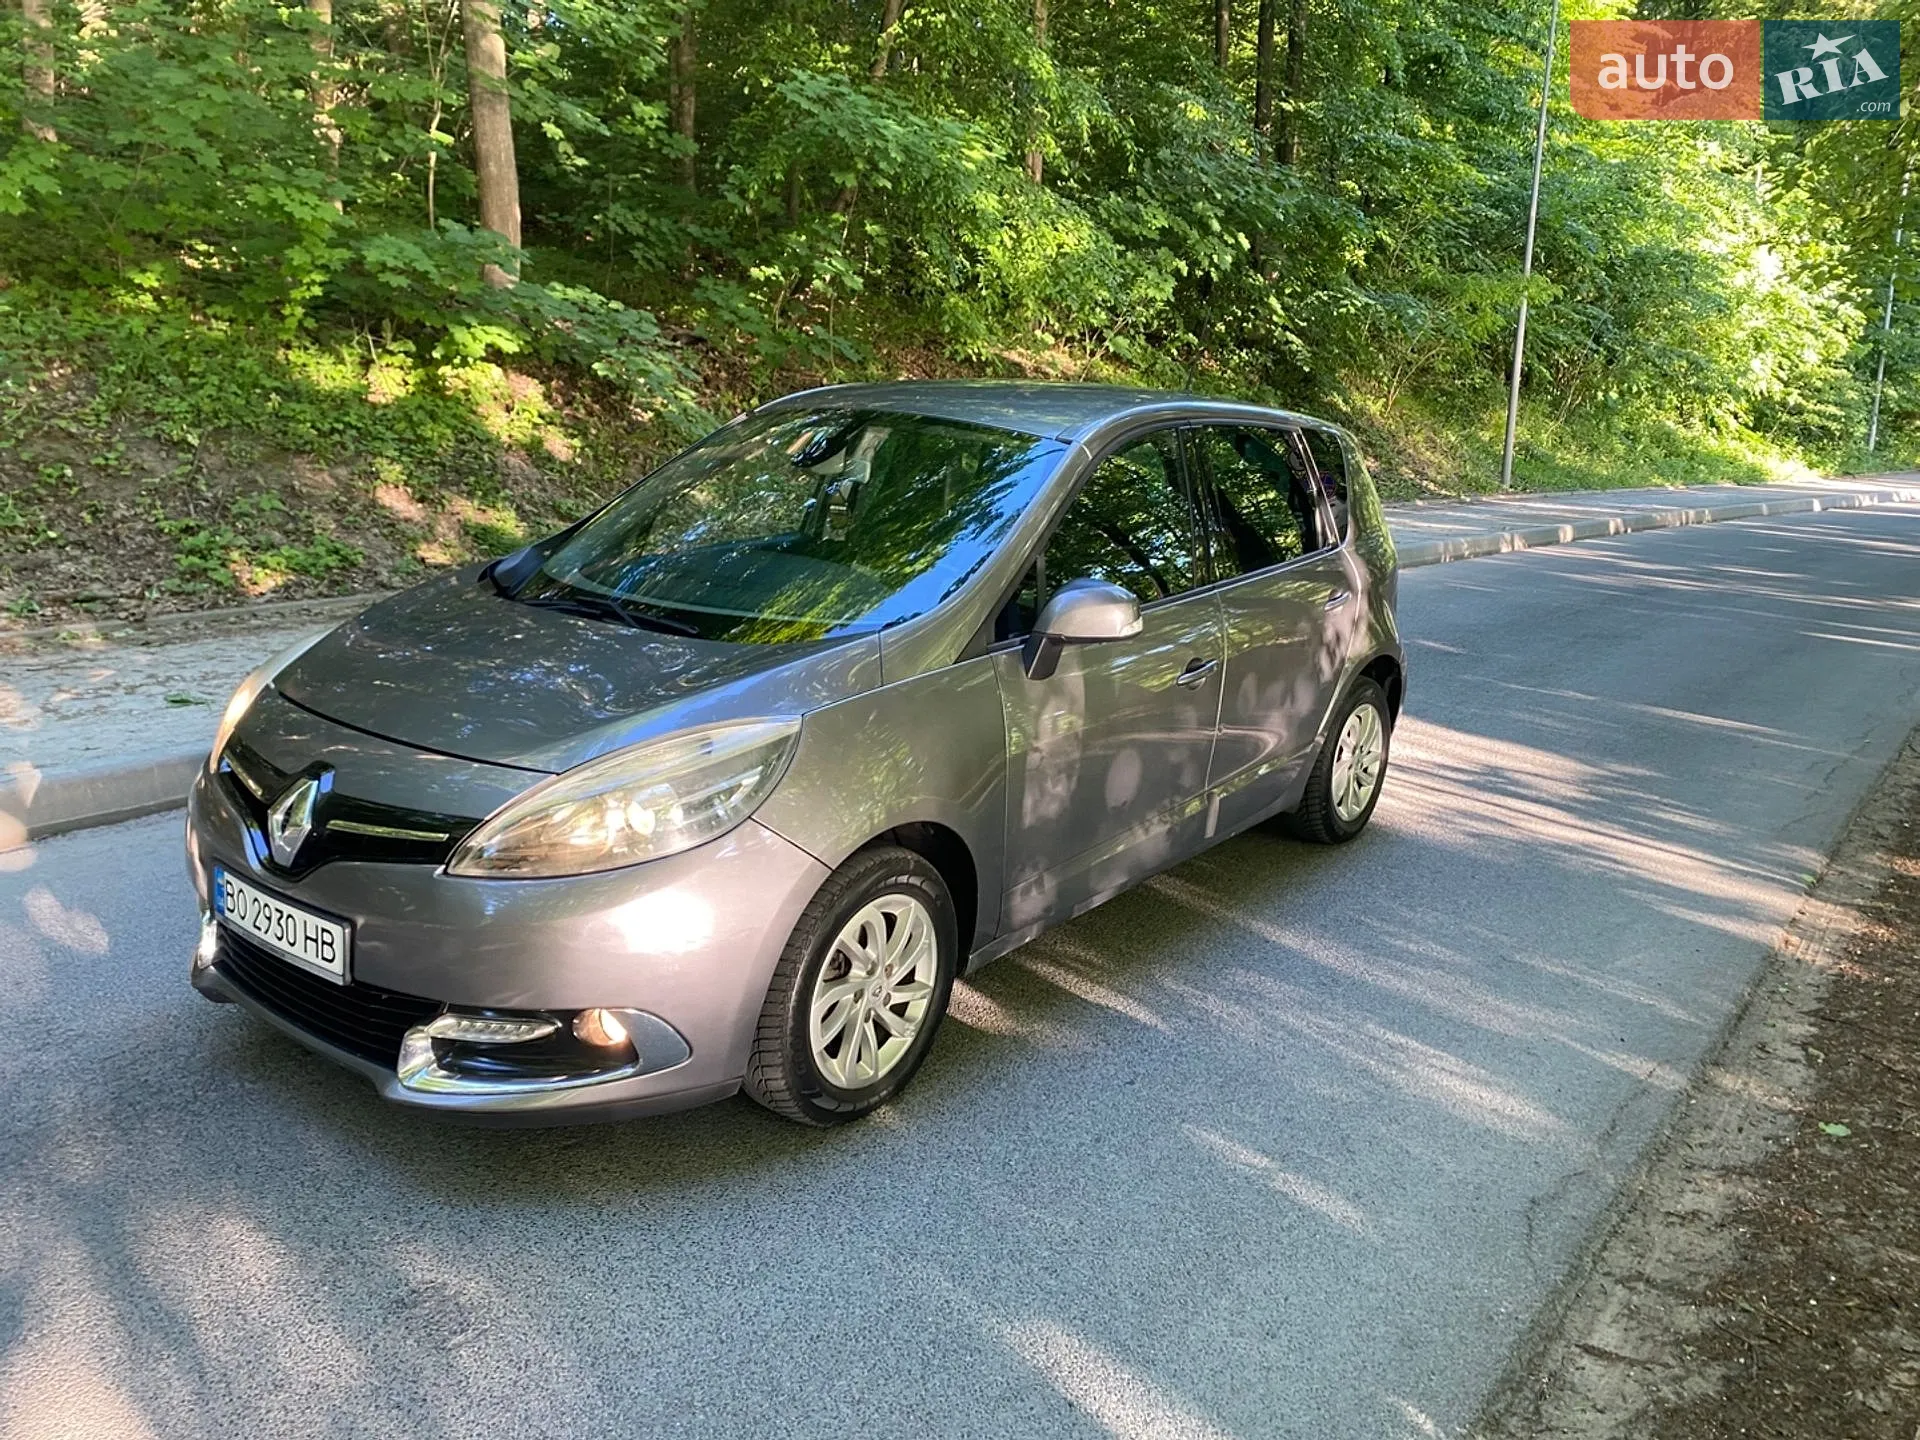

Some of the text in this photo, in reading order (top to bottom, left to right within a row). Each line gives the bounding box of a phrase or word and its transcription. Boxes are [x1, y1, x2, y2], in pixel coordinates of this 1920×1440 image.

[225, 880, 336, 963] BO 2930 HB
